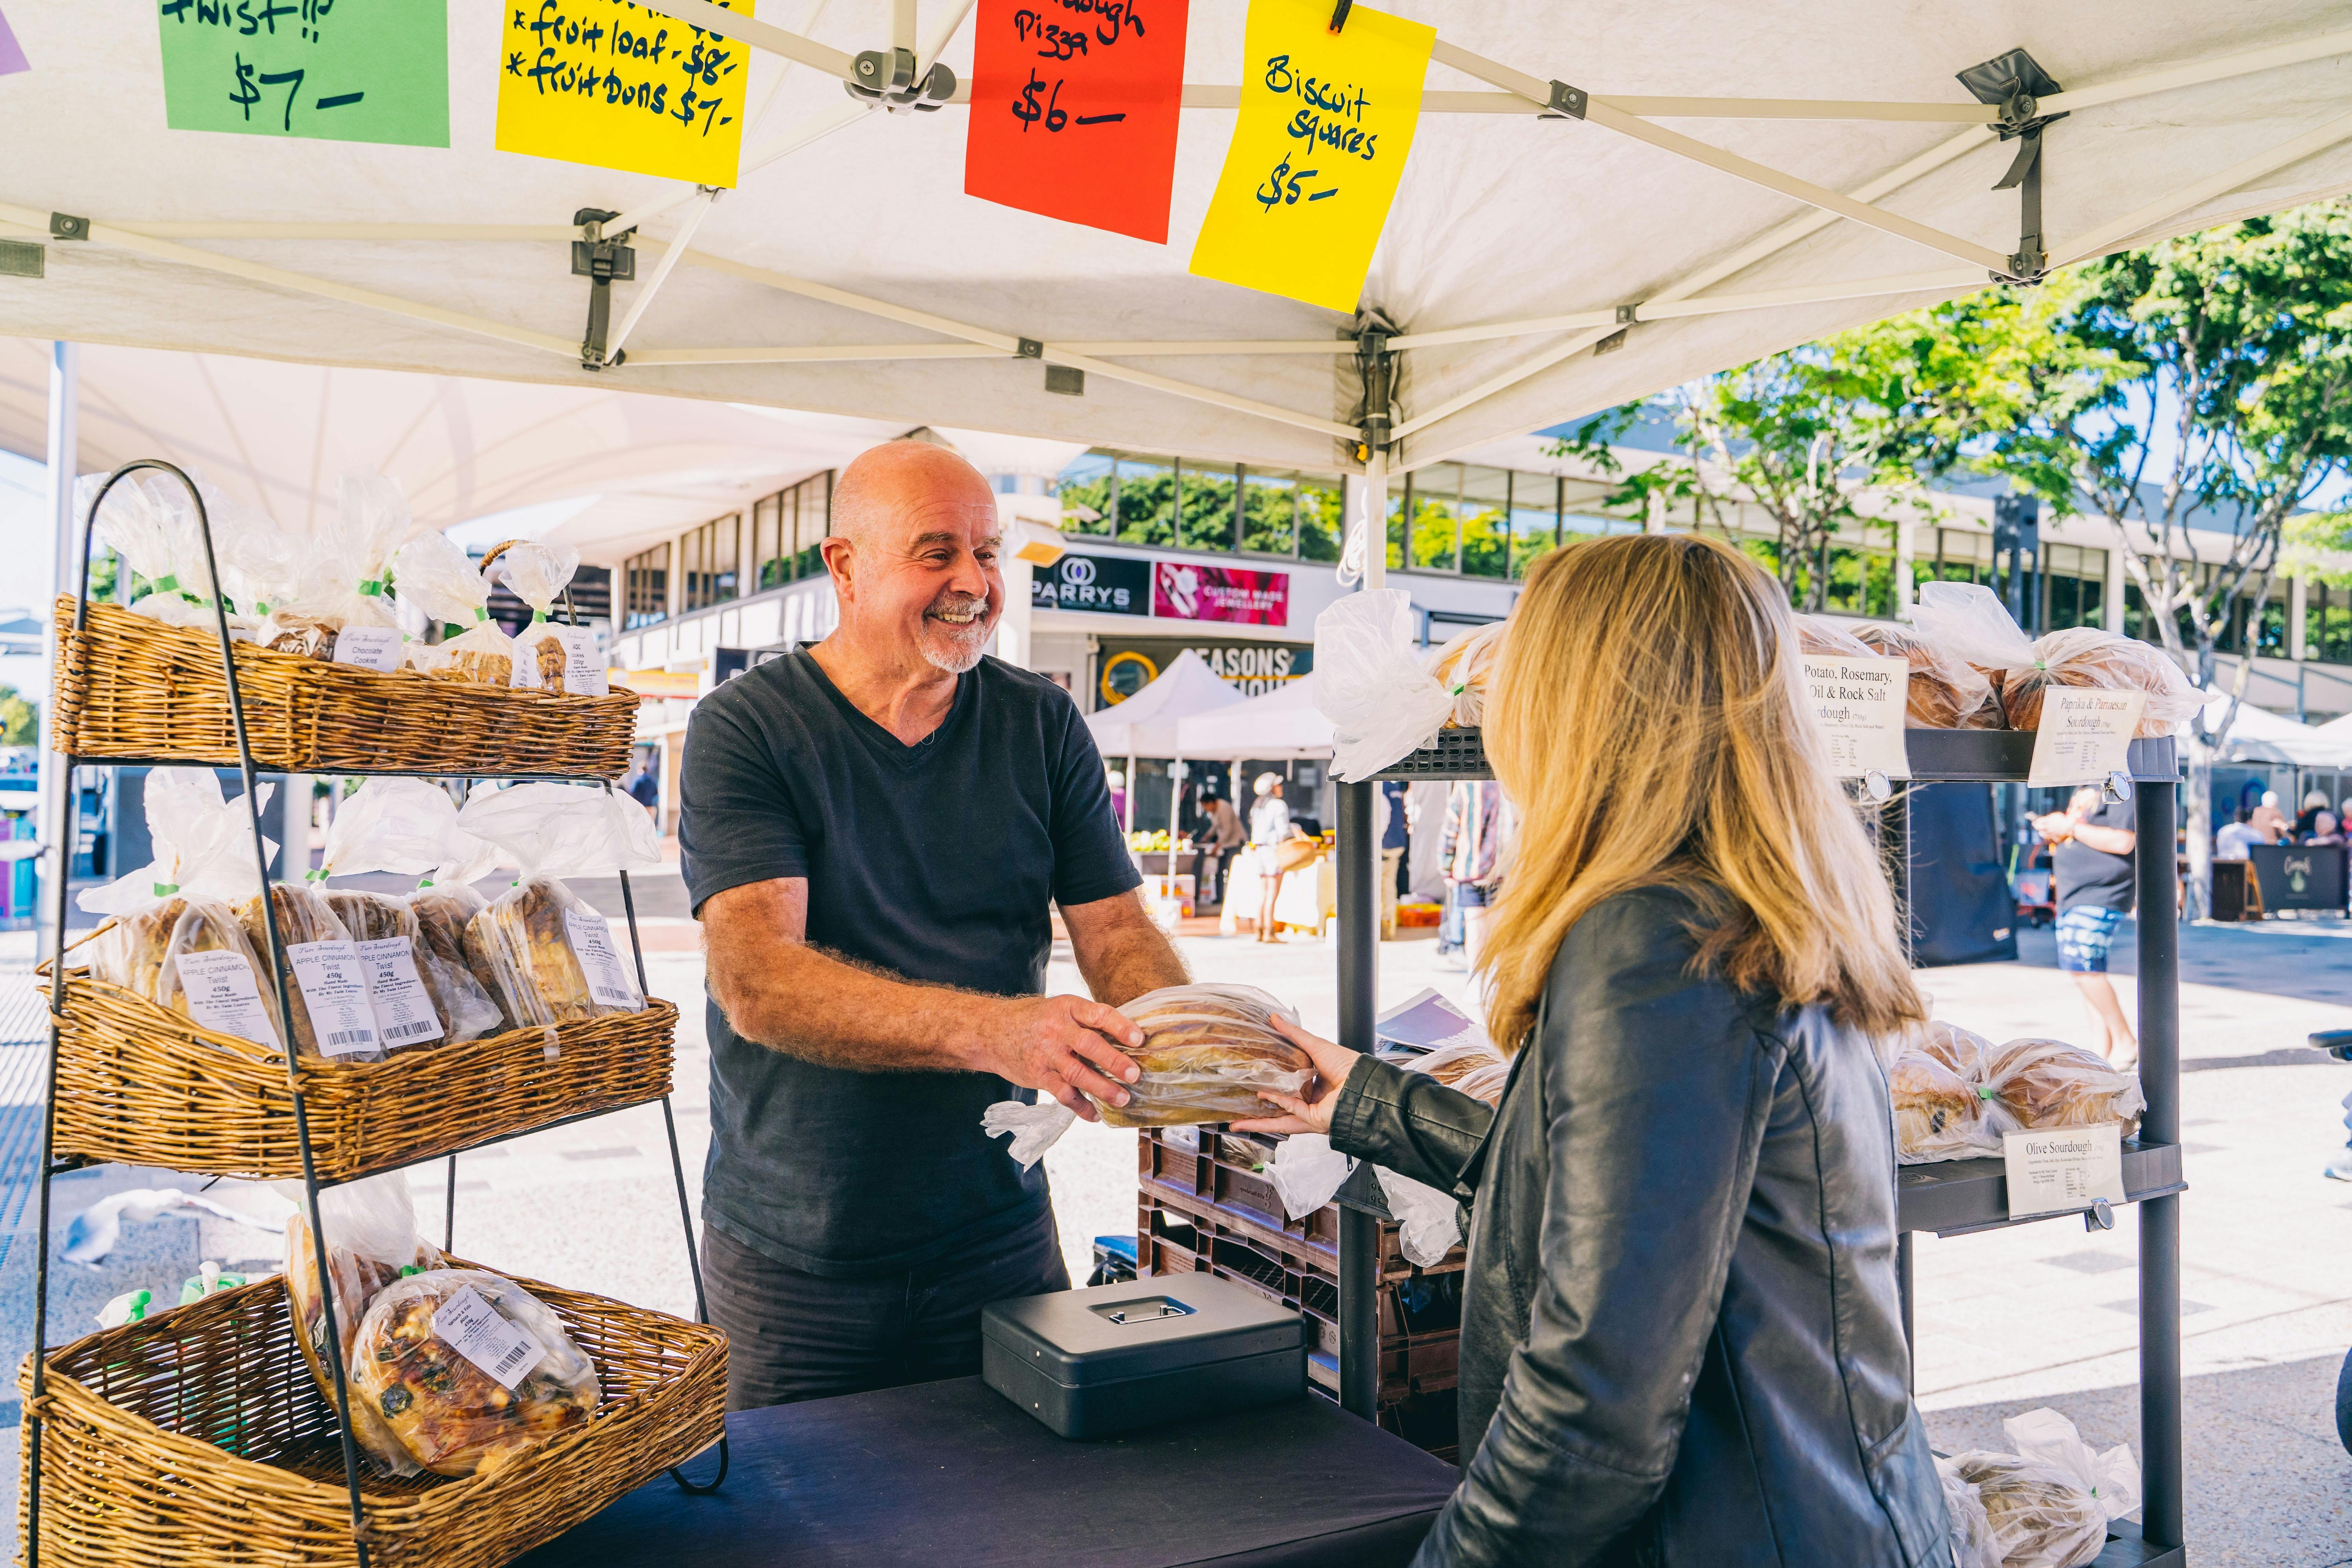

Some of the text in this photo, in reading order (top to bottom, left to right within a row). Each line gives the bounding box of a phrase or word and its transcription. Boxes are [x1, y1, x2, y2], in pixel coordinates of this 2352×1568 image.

[1265, 55, 1371, 123] Biscuit
[1032, 581, 1130, 606] PARRYS
[1203, 585, 1283, 602] CUSTOM MADE
[1213, 597, 1273, 611] JEWELLERY
[1805, 664, 1892, 685] Potato, Rosemary,
[1827, 686, 1835, 699] &
[1839, 687, 1864, 700] Rock
[1867, 688, 1886, 701] Salt
[2060, 697, 2127, 712] Paprika & Parmesan
[2066, 715, 2101, 730] Sourdough
[583, 925, 608, 933] CINNAMON
[373, 941, 402, 950] Sourdough
[296, 956, 320, 965] APPLE
[377, 950, 409, 960] CINNAMON
[208, 964, 250, 974] CINNAMON
[376, 961, 393, 970] Twist
[207, 975, 229, 984] Twist
[2026, 1143, 2047, 1155] Olive
[2049, 1140, 2092, 1154] Sourdough
[446, 1292, 469, 1316] Sourdough
[448, 1312, 462, 1327] Spinach
[460, 1314, 469, 1324] pizza
[465, 1318, 474, 1327] 450g
